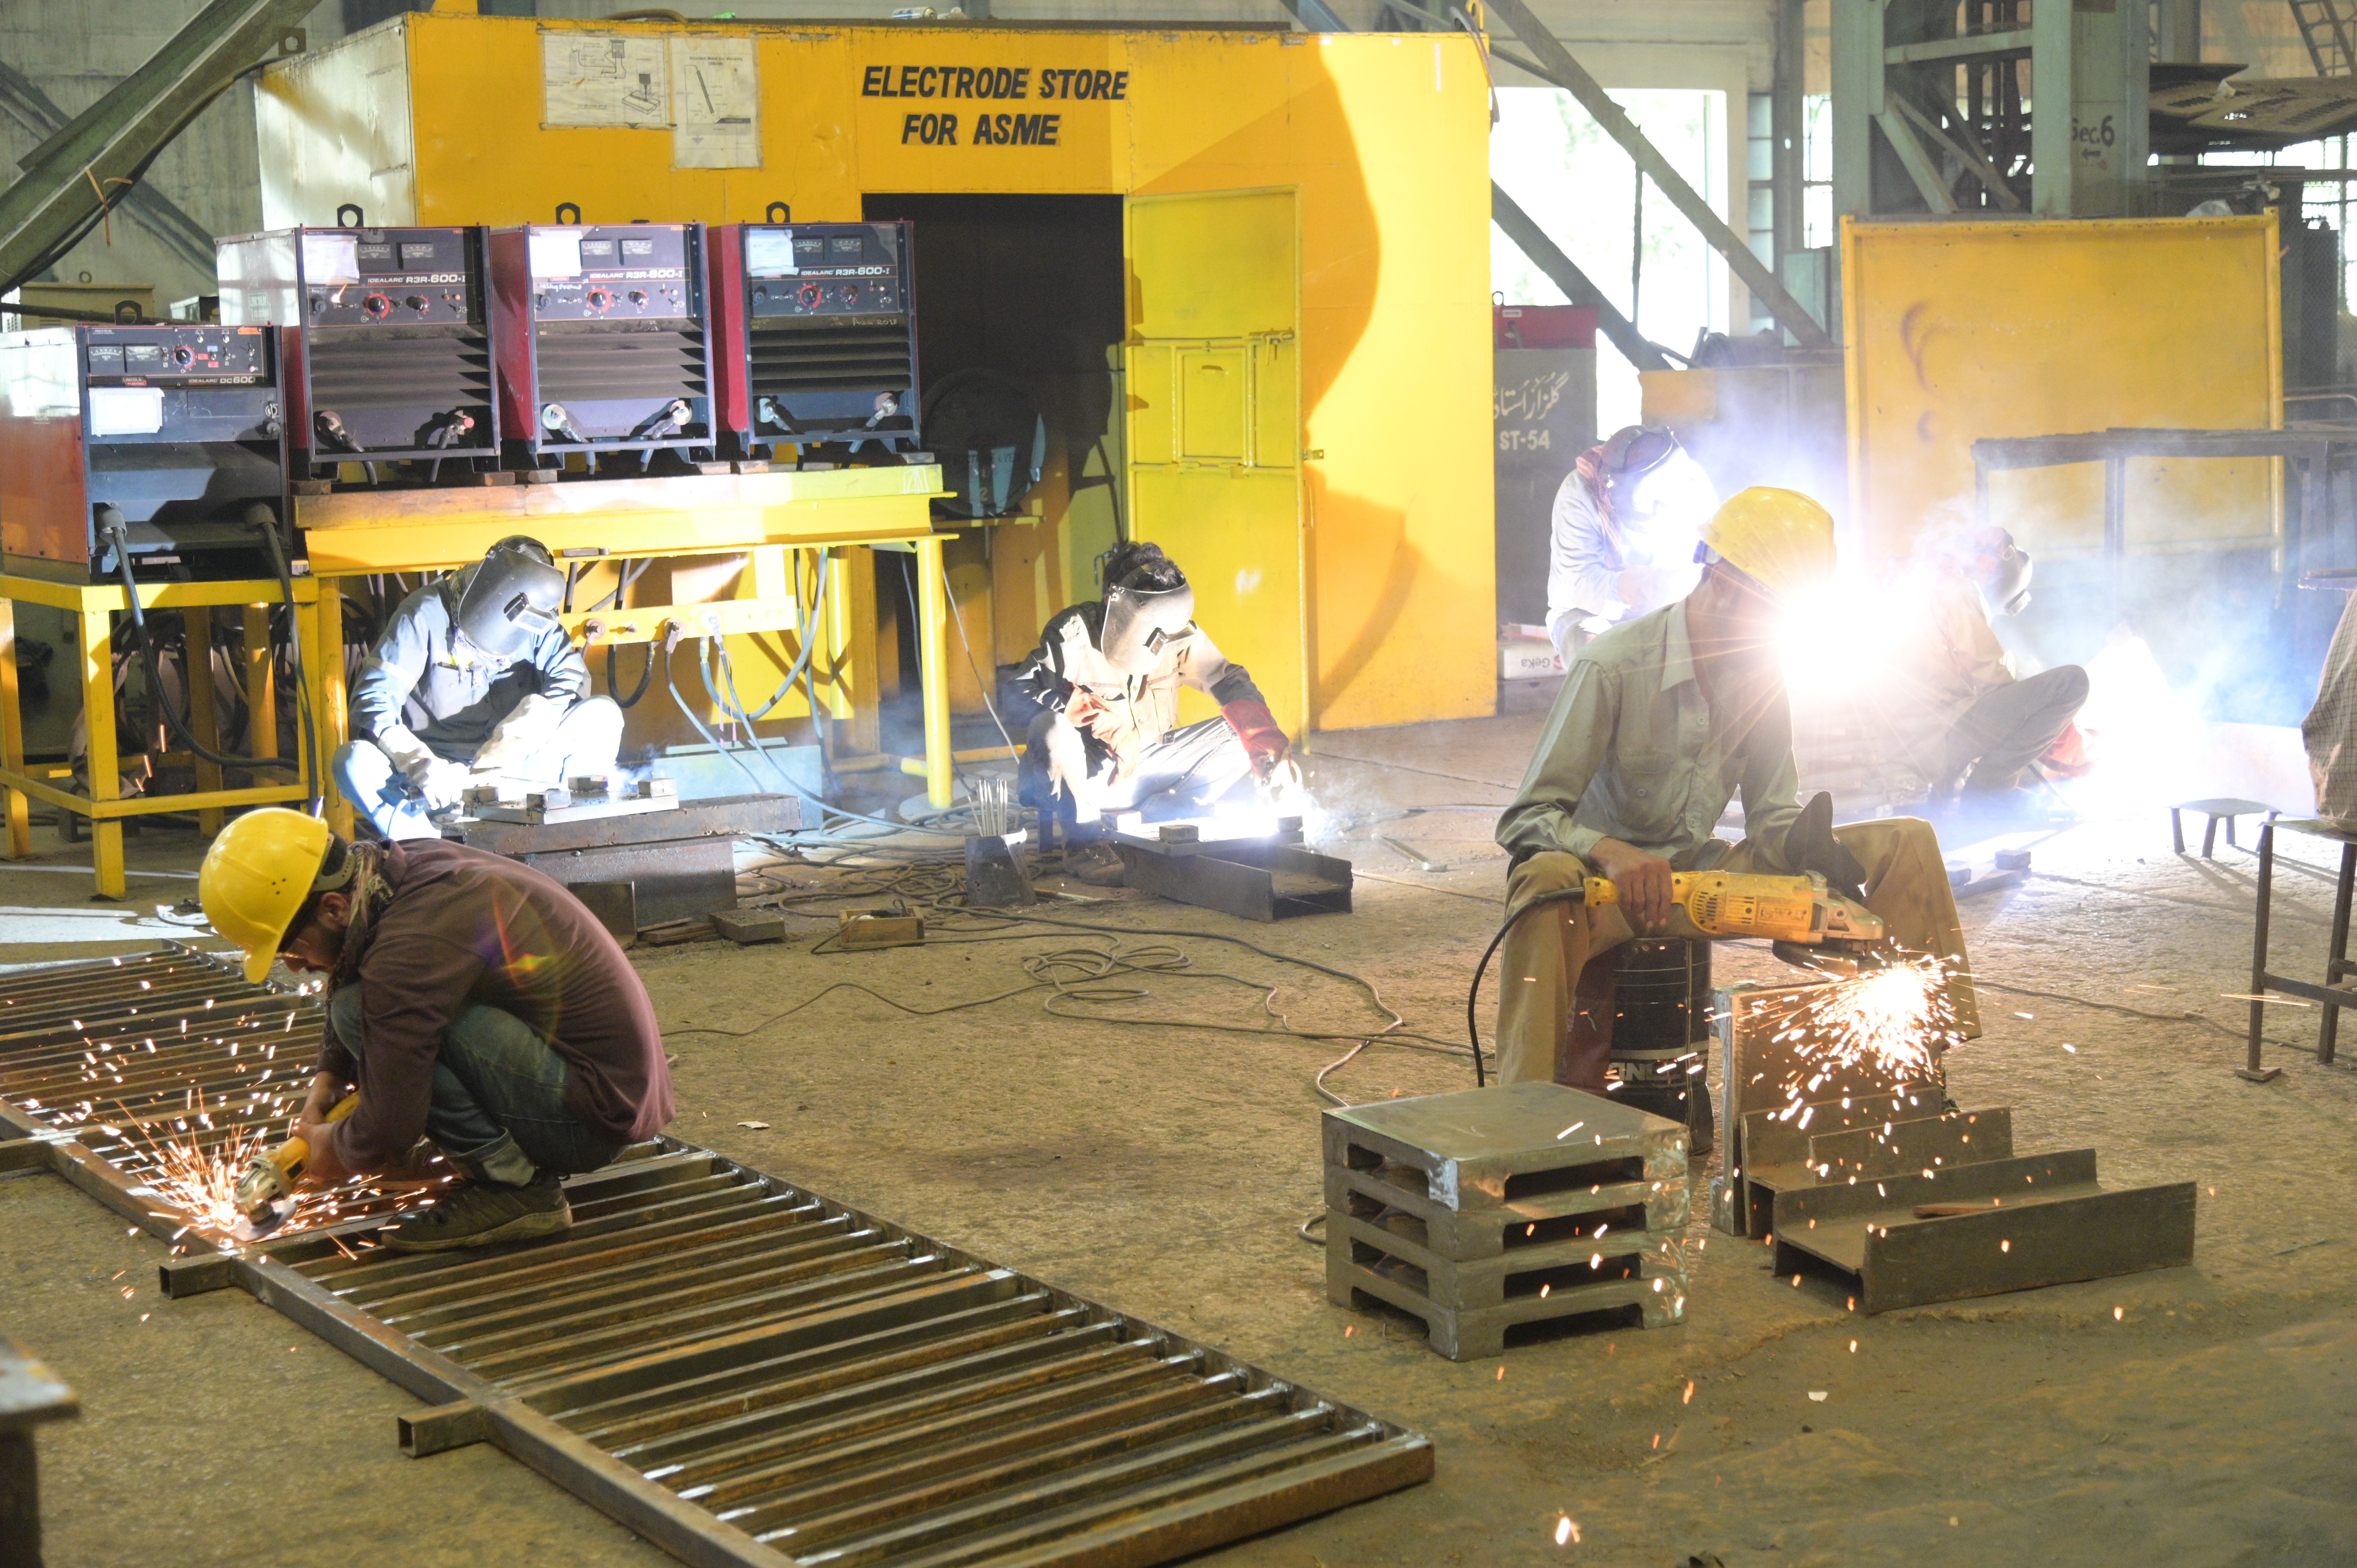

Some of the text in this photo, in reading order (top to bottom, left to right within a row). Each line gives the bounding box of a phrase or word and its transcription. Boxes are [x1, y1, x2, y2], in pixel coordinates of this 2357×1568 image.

[862, 66, 1129, 100] ELECTRODE STORE
[901, 114, 1061, 146] FOR ASME
[1500, 430, 1550, 450] ST-54
[1521, 657, 1550, 669] GeKa
